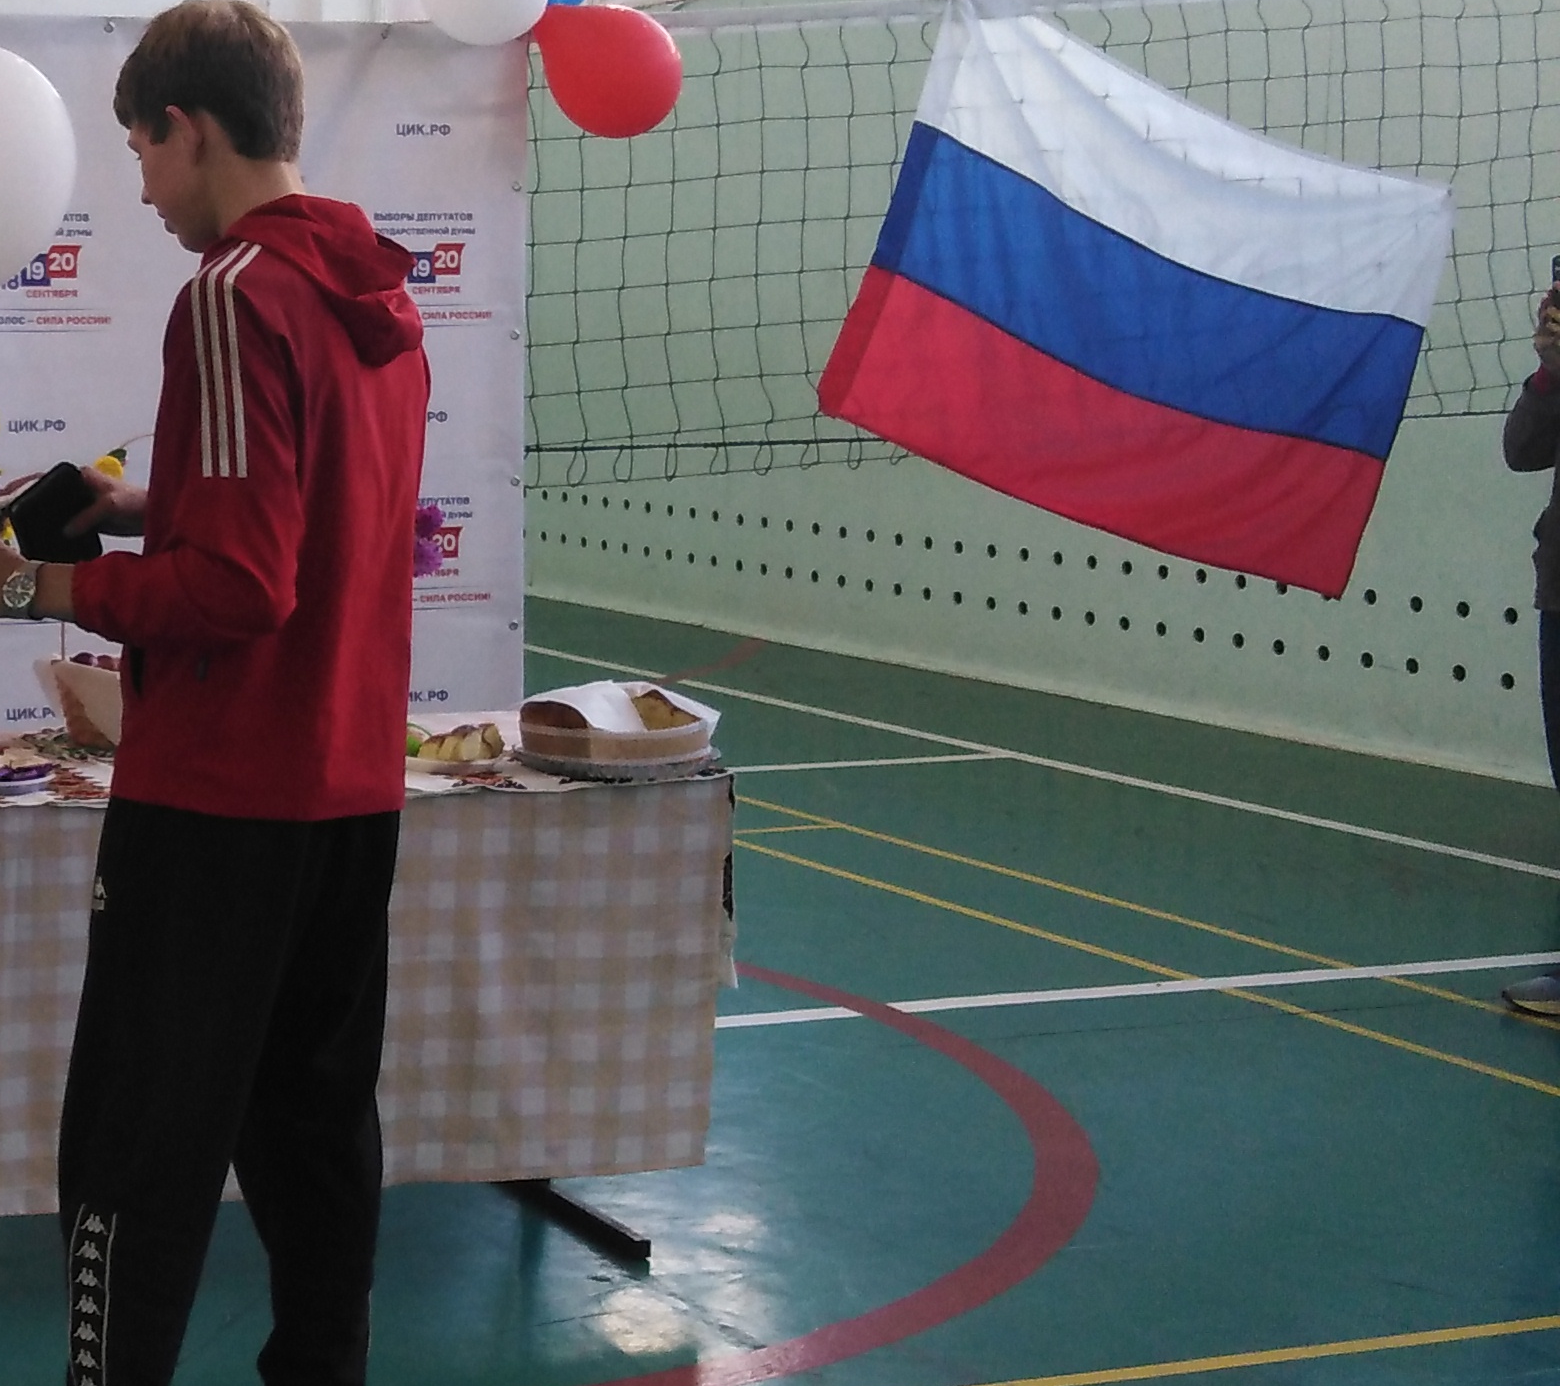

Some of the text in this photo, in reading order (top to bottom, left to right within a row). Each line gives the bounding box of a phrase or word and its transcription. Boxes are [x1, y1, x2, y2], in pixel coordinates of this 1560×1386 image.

[396, 123, 451, 136] ЦИК.РФ
[374, 213, 473, 221] ВЫБОРЫ ДЕПУТАТОВ
[434, 250, 459, 269] 20
[26, 261, 44, 280] 19
[48, 252, 75, 271] 20
[26, 289, 78, 298] СЕНТЯБРЯ
[413, 286, 460, 294] СЕНТЯБРЯ
[36, 316, 63, 325] СИЛА
[67, 316, 111, 325] РОССИИ!
[8, 419, 66, 433] ЦИК.РФ
[419, 497, 470, 505] ЕПУТАТОВ
[420, 594, 446, 603] СИЛА
[448, 593, 491, 601] РОССИИ!
